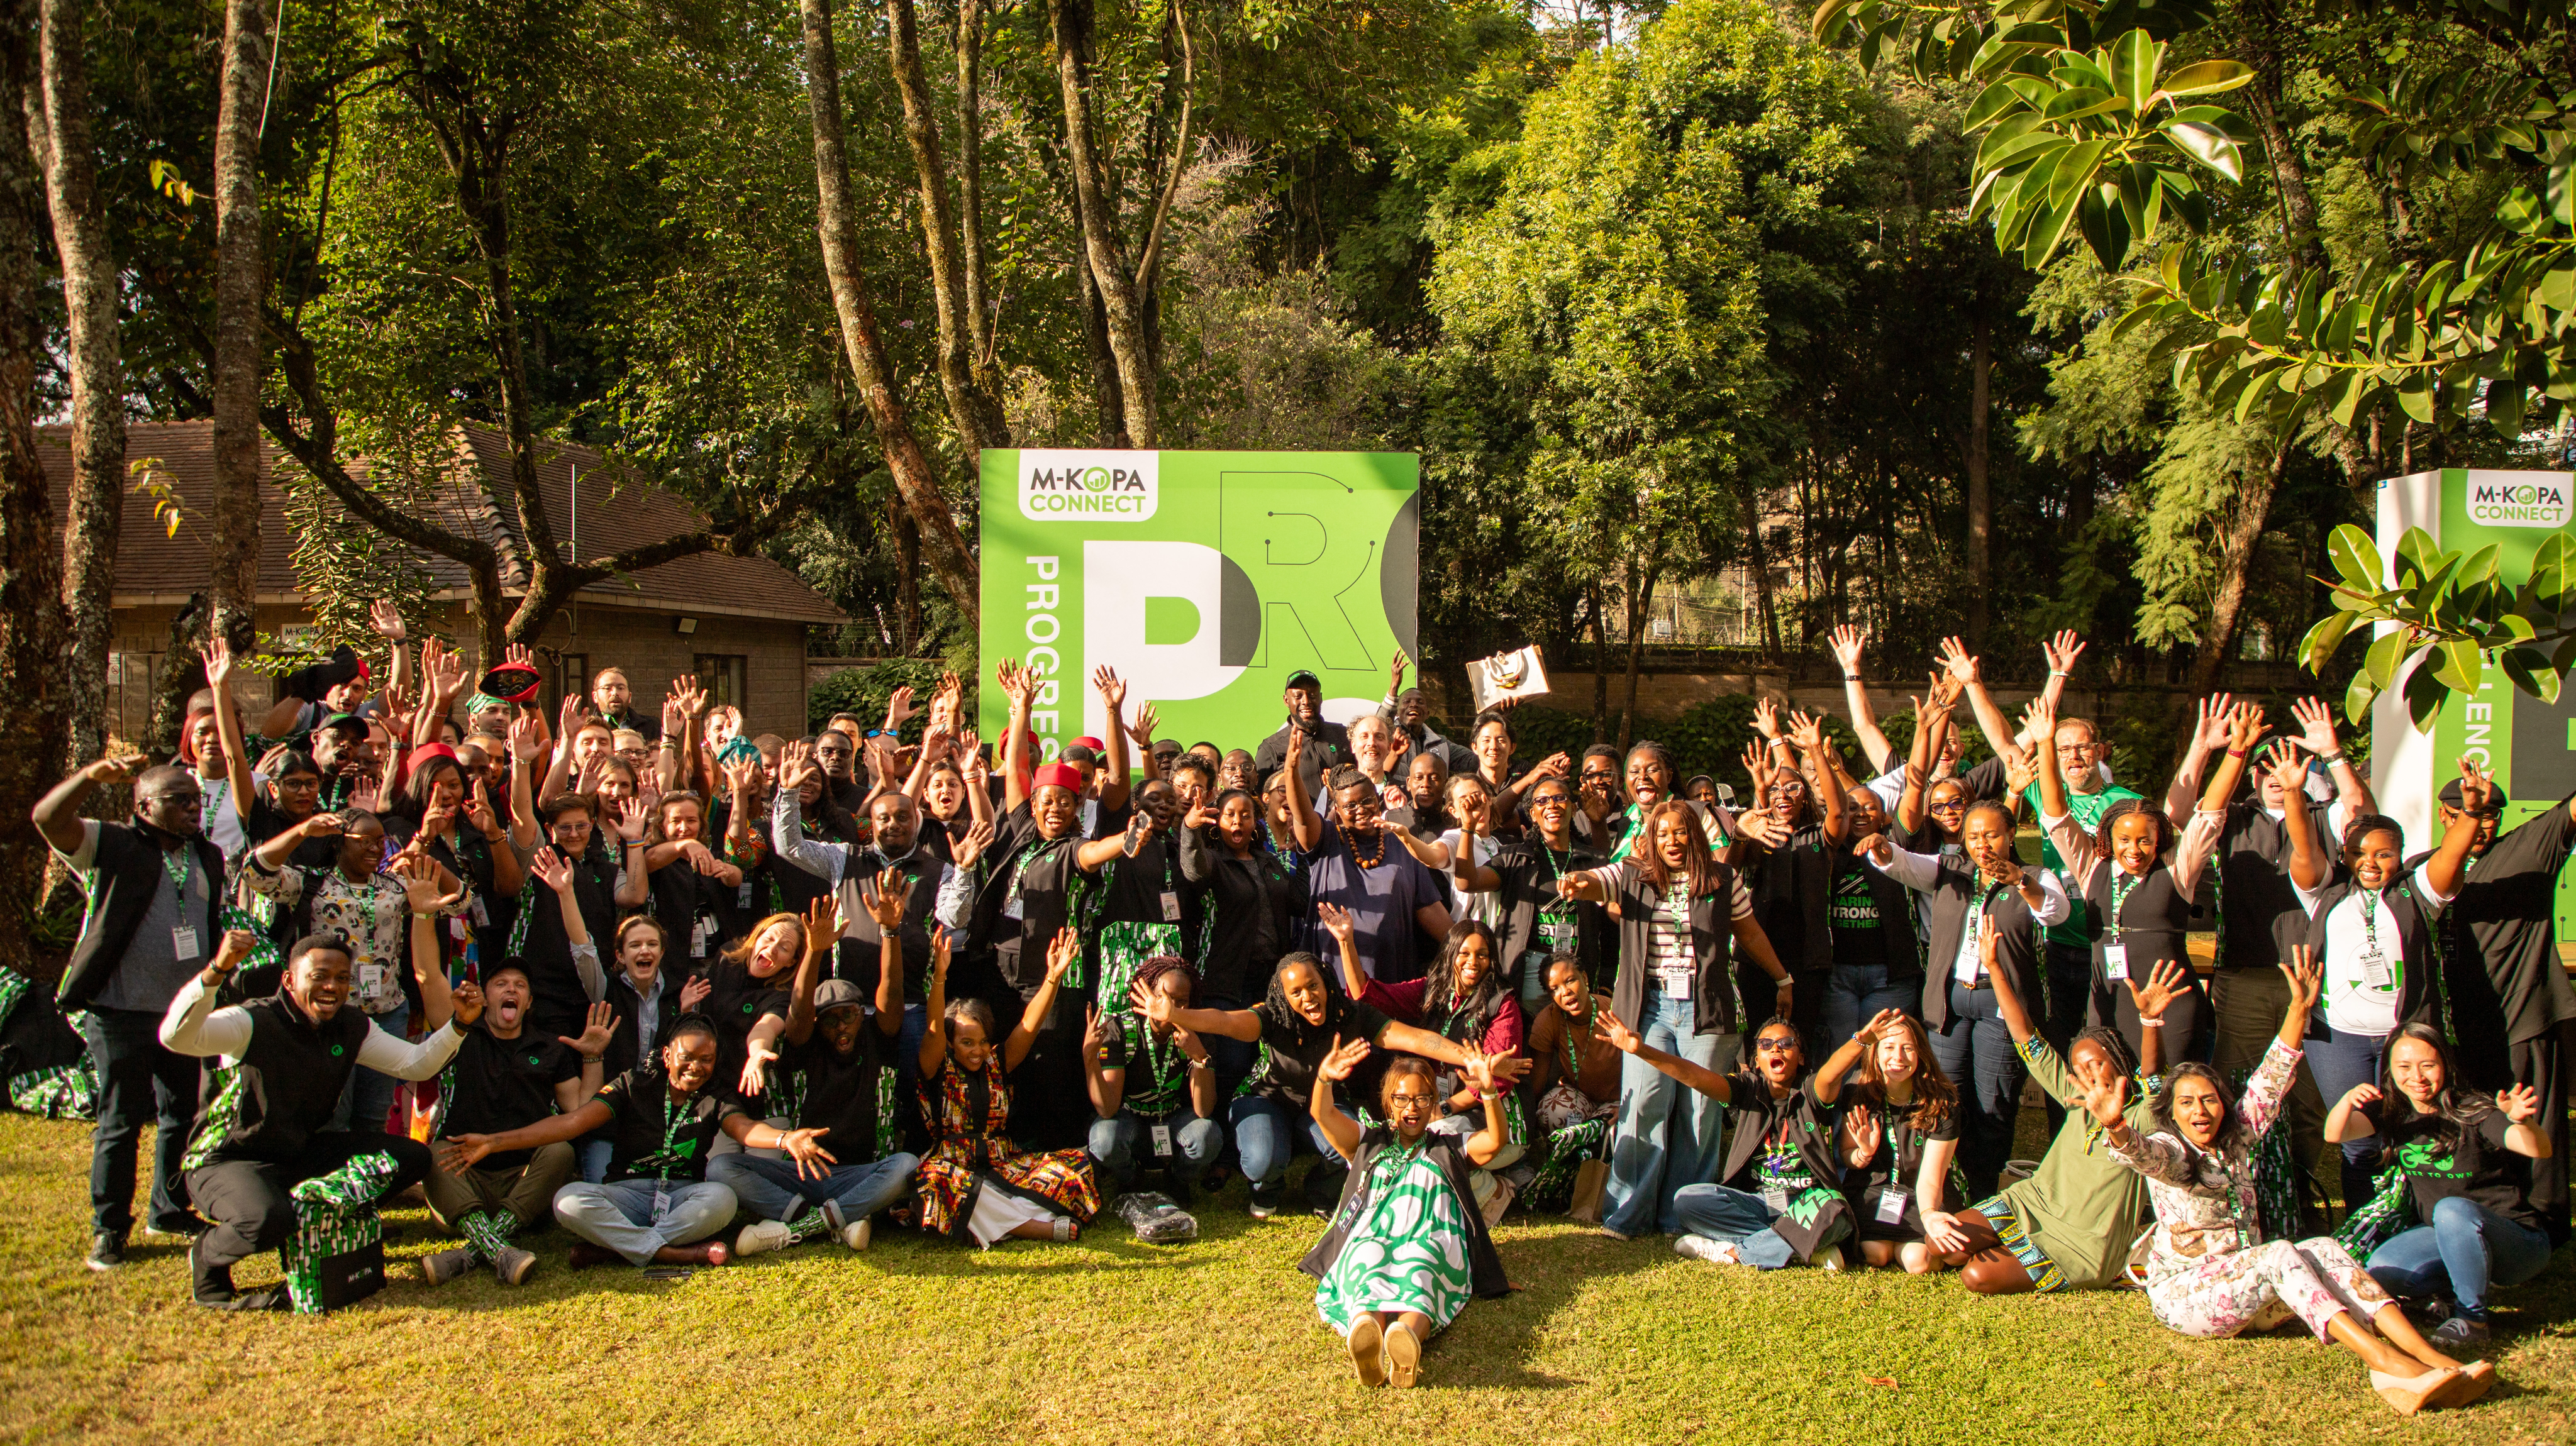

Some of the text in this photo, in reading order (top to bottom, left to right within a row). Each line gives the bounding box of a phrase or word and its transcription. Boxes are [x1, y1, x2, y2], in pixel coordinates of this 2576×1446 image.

[1030, 466, 1146, 492] M-KOPA
[2475, 485, 2563, 505] M-KOPA
[1030, 494, 1146, 513] CONNECT
[2474, 505, 2563, 521] CONNECT
[285, 626, 320, 636] M-KOPA
[1835, 896, 1875, 907] ARIN
[1833, 907, 1880, 919] TRONG
